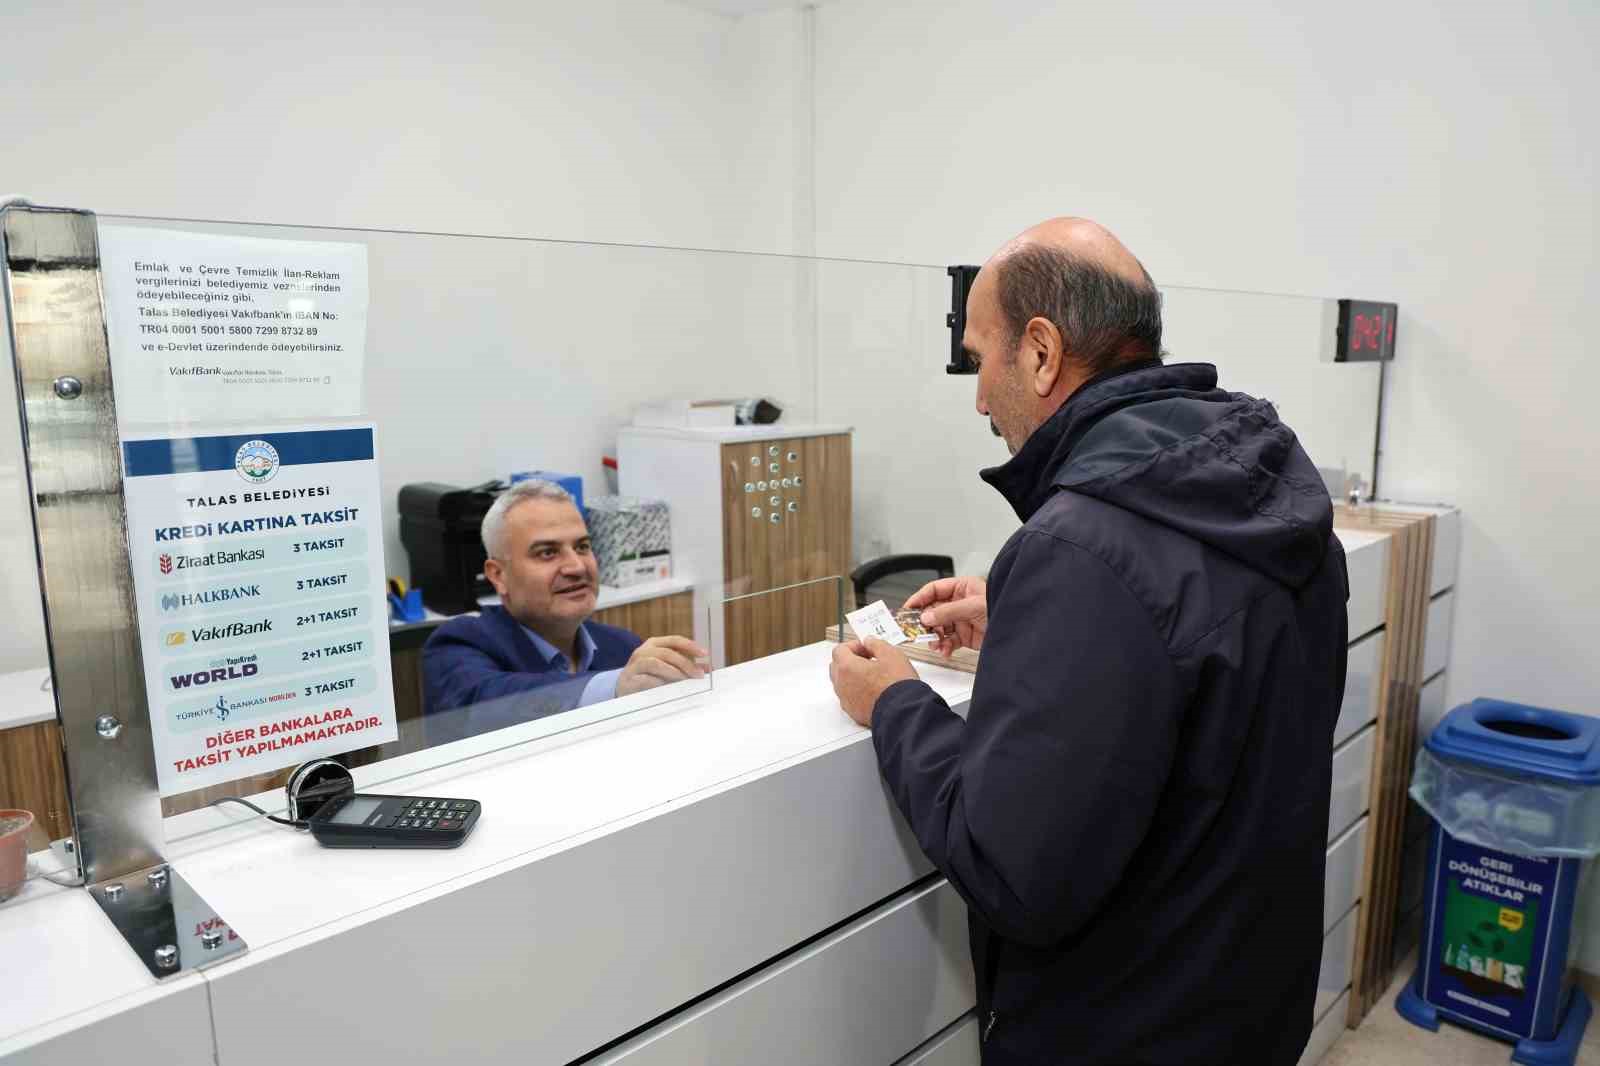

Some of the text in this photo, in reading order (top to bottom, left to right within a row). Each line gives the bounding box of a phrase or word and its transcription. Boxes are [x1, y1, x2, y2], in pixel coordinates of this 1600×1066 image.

[134, 261, 169, 273] Emlak
[180, 265, 193, 273] ve
[236, 266, 278, 278] Temizlik
[136, 278, 201, 288] vergilerinizi
[207, 279, 268, 291] belediyemiz
[139, 307, 168, 318] Talas
[172, 308, 228, 320] Belediyesi
[140, 324, 318, 336] TR04 0001 5001 5800 7299 8732 89
[141, 343, 155, 351] ve
[158, 342, 203, 351] e-Devlet
[205, 342, 269, 352] üzerindende
[186, 485, 330, 508] TALAS BELEDİYESİ
[155, 506, 359, 543] KREDİ KARTINA TAKSİT
[177, 537, 345, 570] Ziraat Bankası 3 TAKSİT
[181, 574, 348, 607] HALKBANK 3 TAKSİT
[191, 607, 359, 643] VakıfBank 2+1 TAKSİT
[170, 641, 364, 689] WORLD 2+1 TAKSİT
[229, 697, 268, 711] BANKASI
[304, 686, 313, 697] 3
[315, 678, 356, 696] TAKSİT
[173, 715, 383, 774] TAKSİT YAPILMAMAKTADIR.
[205, 706, 353, 751] DİĞER BANKALARA
[1462, 878, 1524, 903] ATIKLAR
